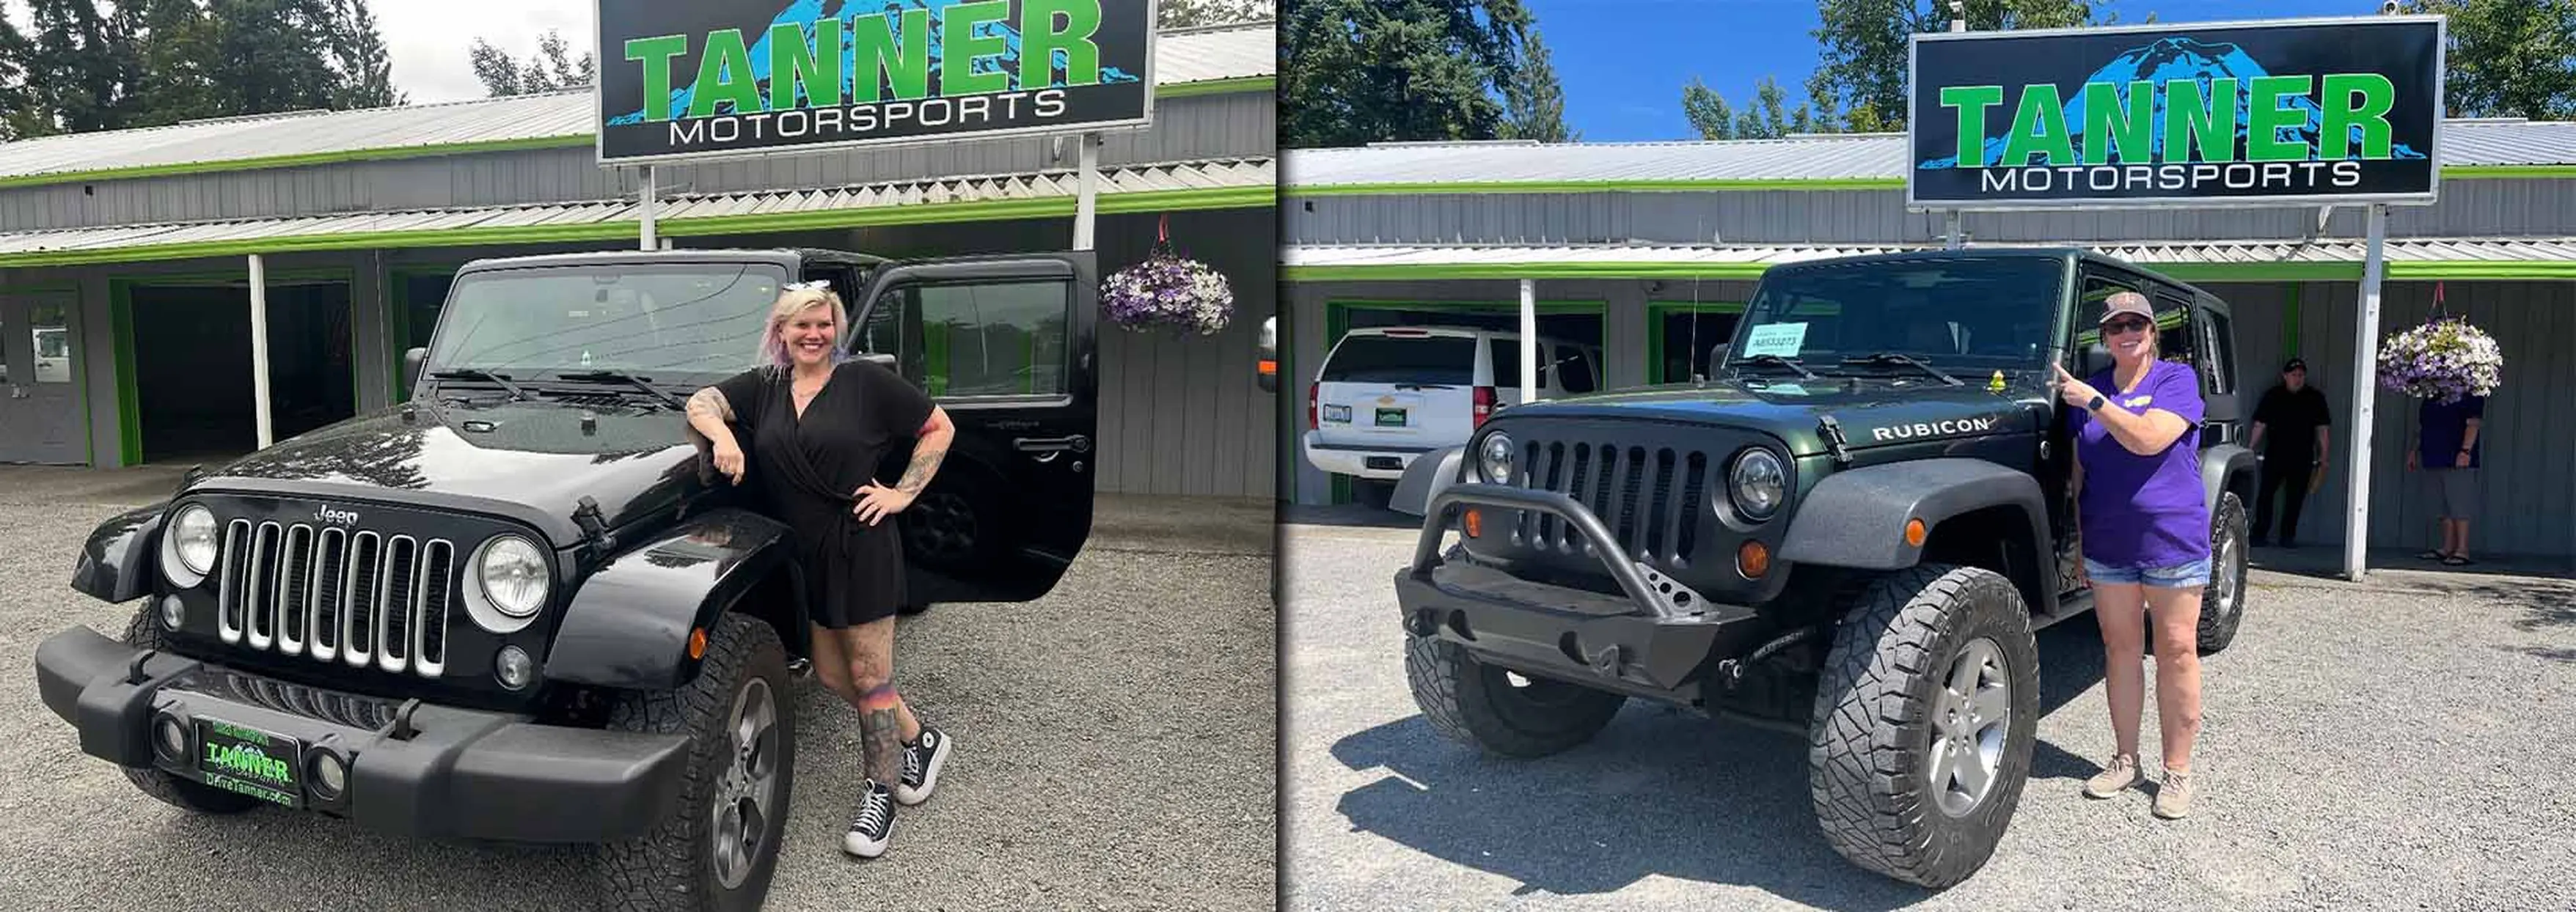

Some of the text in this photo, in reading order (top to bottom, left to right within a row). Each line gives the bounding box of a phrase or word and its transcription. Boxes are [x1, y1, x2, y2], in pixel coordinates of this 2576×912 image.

[623, 0, 1102, 123] TANNER
[668, 89, 1066, 147] MOTORSPORTS
[1940, 73, 2396, 169] TANNER
[1981, 161, 2361, 192] MOTORSPORTS
[1873, 417, 1989, 441] RUBICON
[313, 504, 359, 529] Jeep
[206, 741, 290, 782] TANNER
[205, 772, 292, 806] DriveTanner.com
